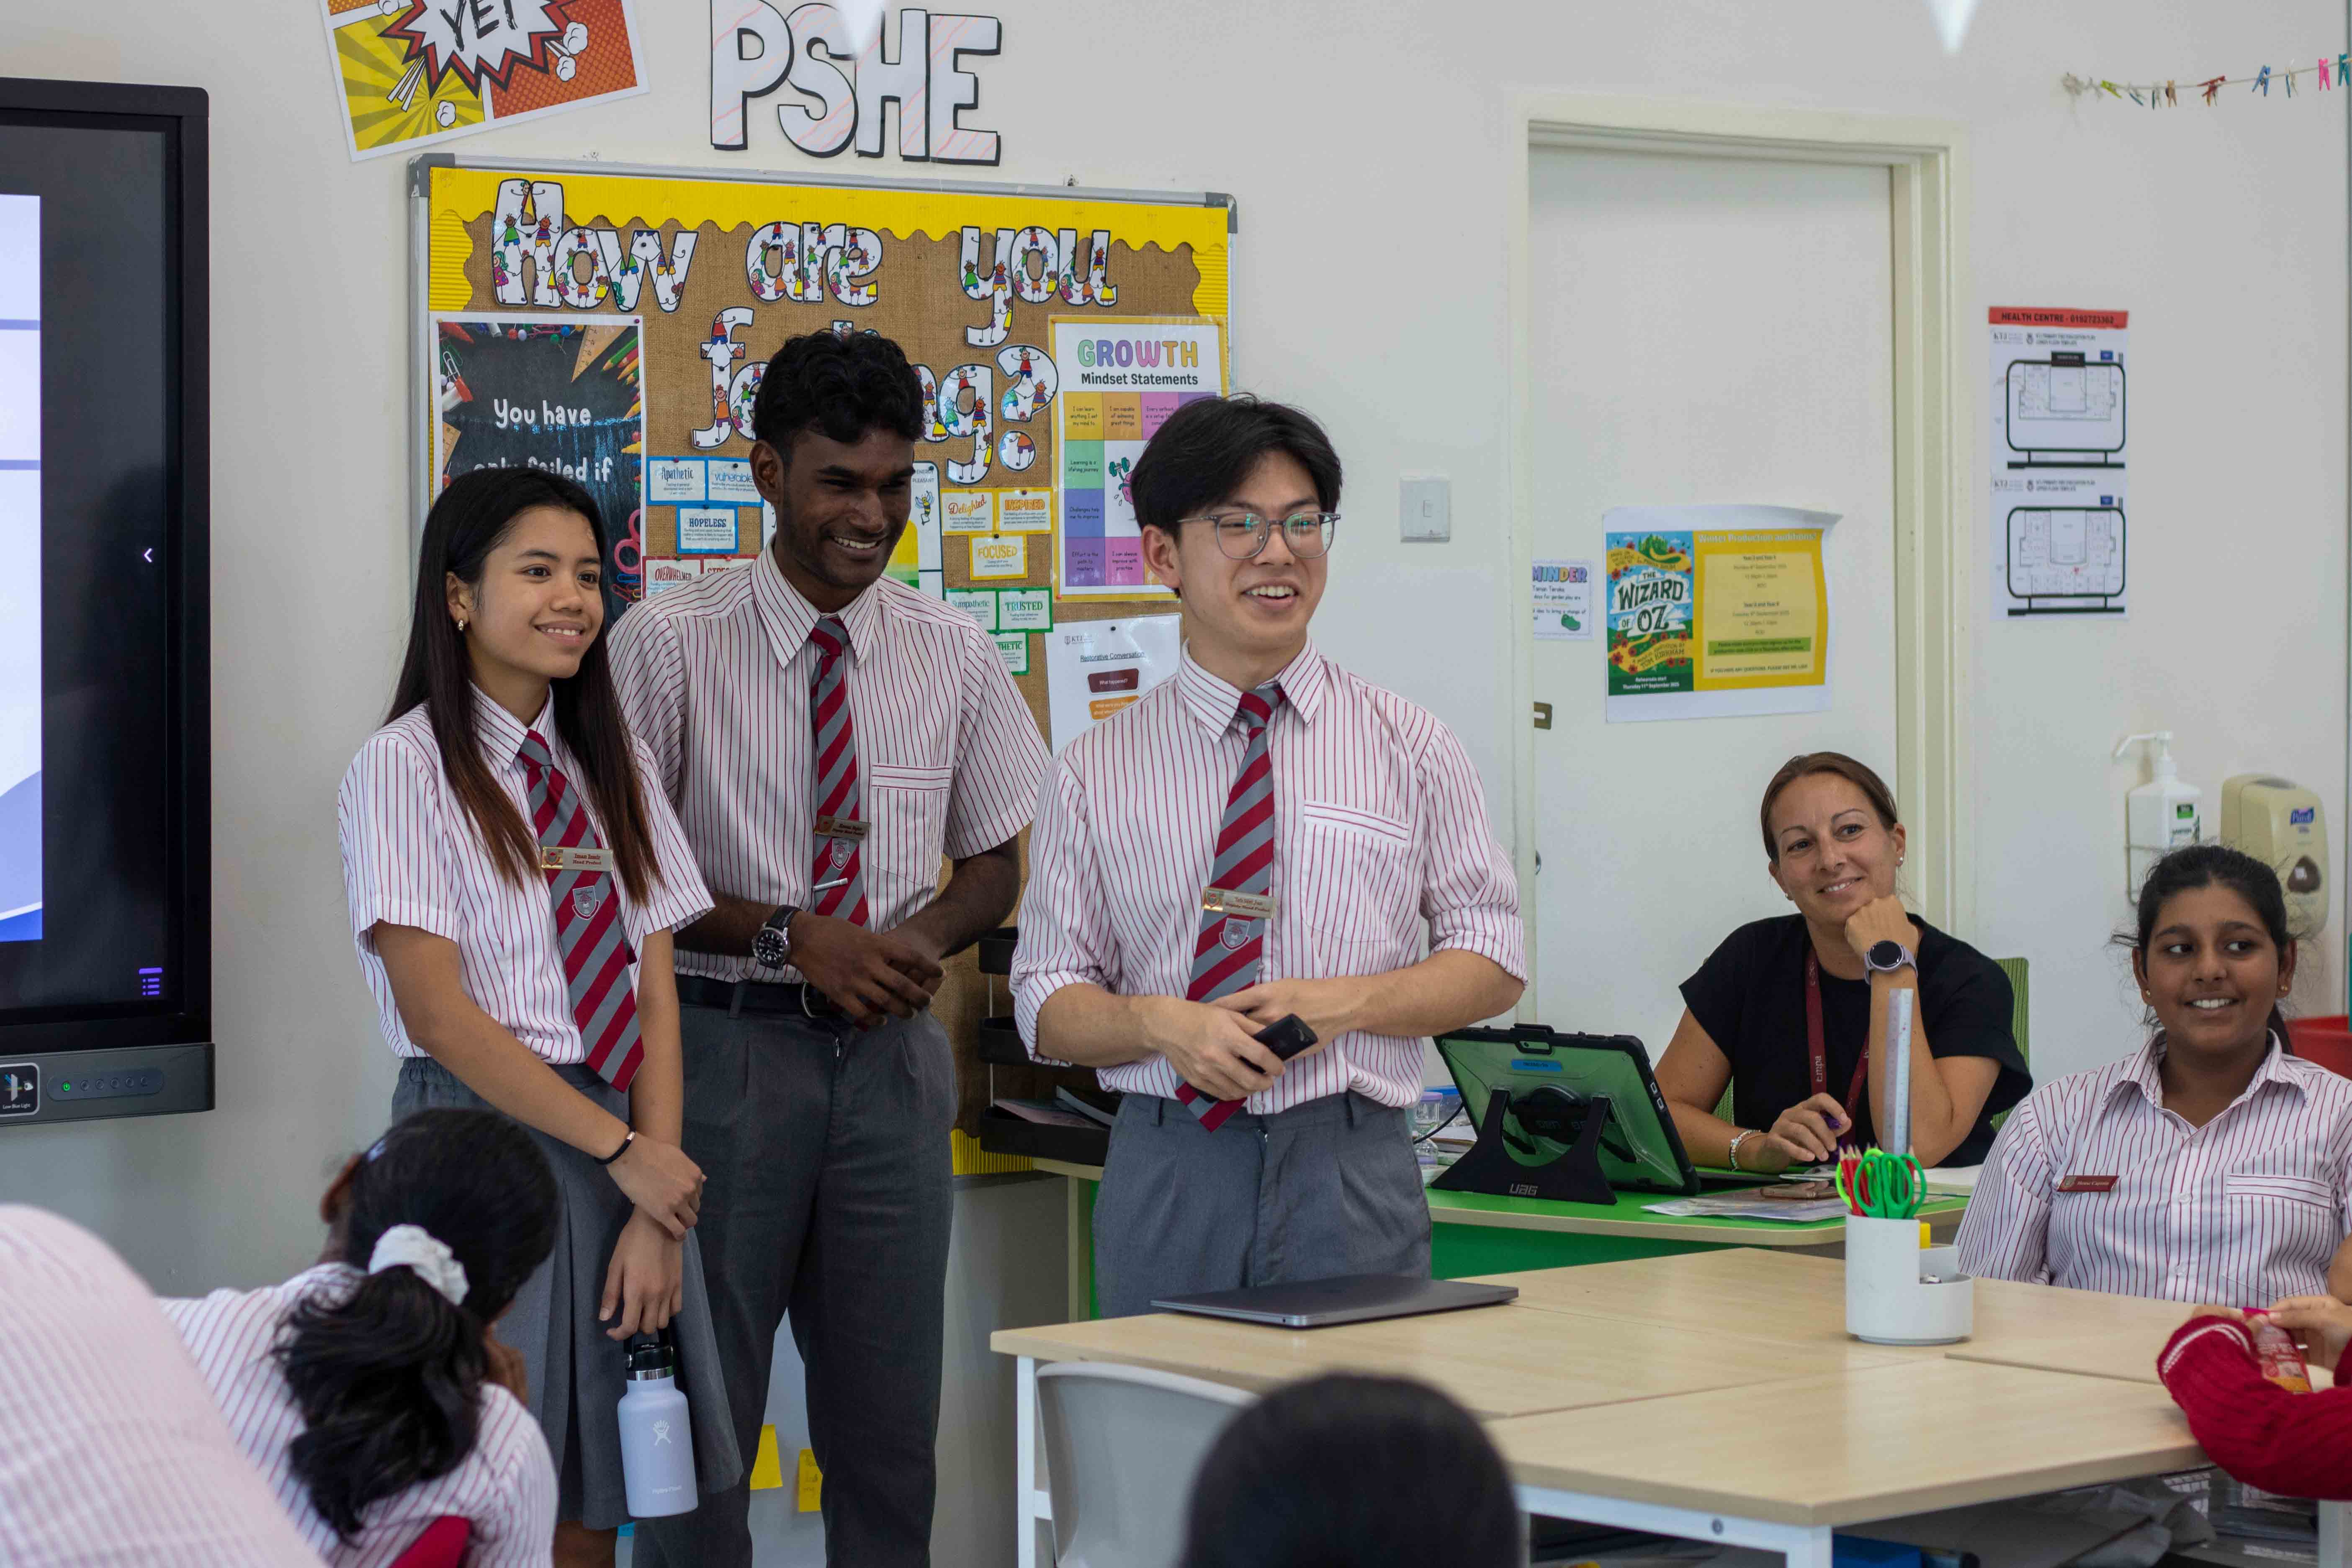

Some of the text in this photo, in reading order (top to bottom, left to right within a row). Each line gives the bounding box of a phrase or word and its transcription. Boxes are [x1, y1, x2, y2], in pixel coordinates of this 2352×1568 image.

[710, 0, 1002, 166] PSHE
[492, 178, 1118, 348] How are you
[2002, 313, 2031, 322] HEALTH
[2034, 313, 2064, 322] CENTRE
[1078, 340, 1198, 367] GROWTH
[1081, 372, 1198, 385] Mindset Statements
[494, 399, 591, 429] You have
[595, 457, 612, 482] if
[661, 467, 694, 481] Apathetic
[948, 494, 986, 517] Delighted
[1004, 499, 1045, 511] INSPIRED
[690, 518, 726, 528] HOPELESS
[978, 545, 1017, 559] FOCUSED
[655, 566, 692, 581] OVERWHELMED
[1532, 566, 1587, 583] MINDER
[1618, 579, 1684, 611] WIZARD
[1005, 601, 1043, 610] TRUSTED
[1637, 604, 1669, 632] OZ
[1080, 651, 1145, 663] Restorative Conversation
